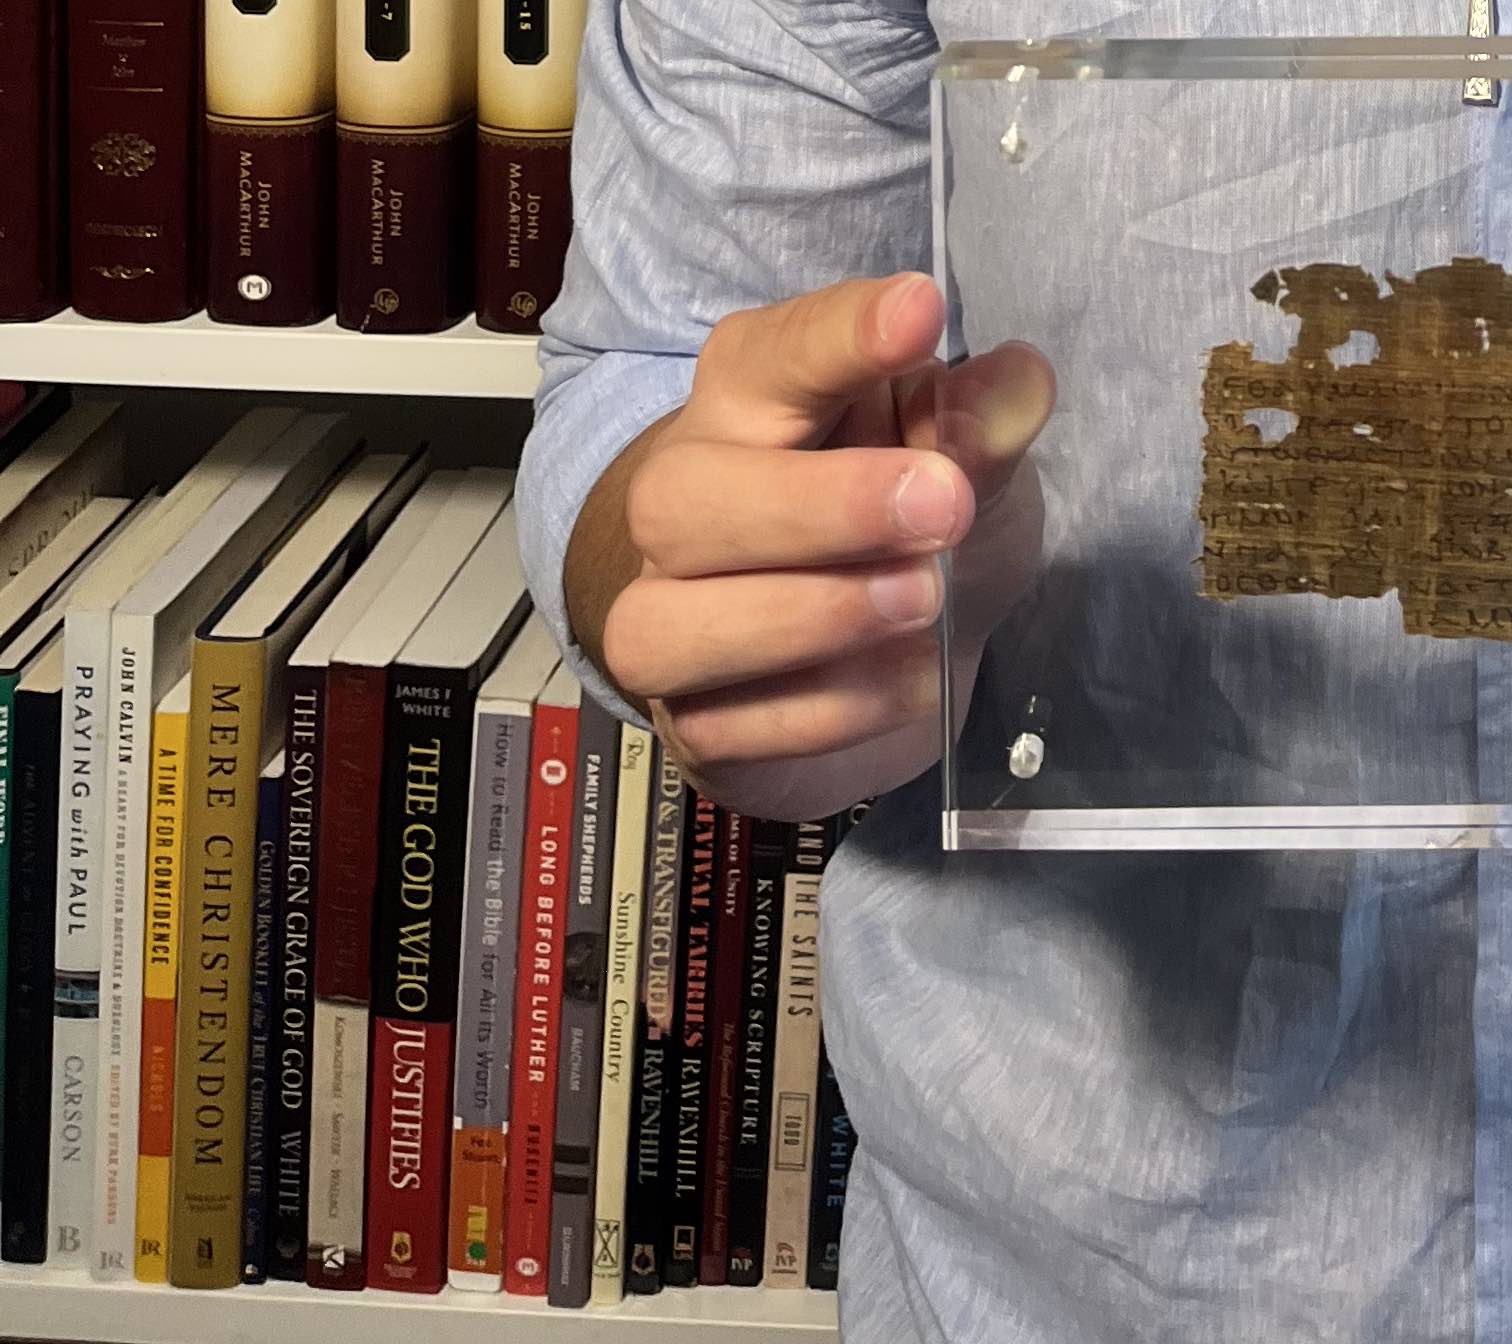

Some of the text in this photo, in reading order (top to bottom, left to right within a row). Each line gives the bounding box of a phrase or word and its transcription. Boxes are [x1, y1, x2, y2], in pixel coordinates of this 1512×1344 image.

[258, 181, 270, 230] JOHN
[68, 666, 93, 935] PRAYING with PAUL
[117, 646, 136, 765] JOHN CALVIN
[152, 749, 176, 964] A TIME FOR CONFIDENCE
[194, 683, 240, 1167] MERE CHRISTENDOM
[280, 689, 316, 1109] THE SOVEREIGN GRACE OF GOD
[387, 738, 440, 1190] THE GOD WHO JUSTIFIES
[528, 826, 558, 1083] LONG BEFORE LUTHER
[604, 891, 636, 1084] Sunshine Country
[740, 878, 773, 1145] KNOWING SCRIPTURE
[63, 1056, 84, 1162] CARSON
[278, 1131, 302, 1218] WHITE
